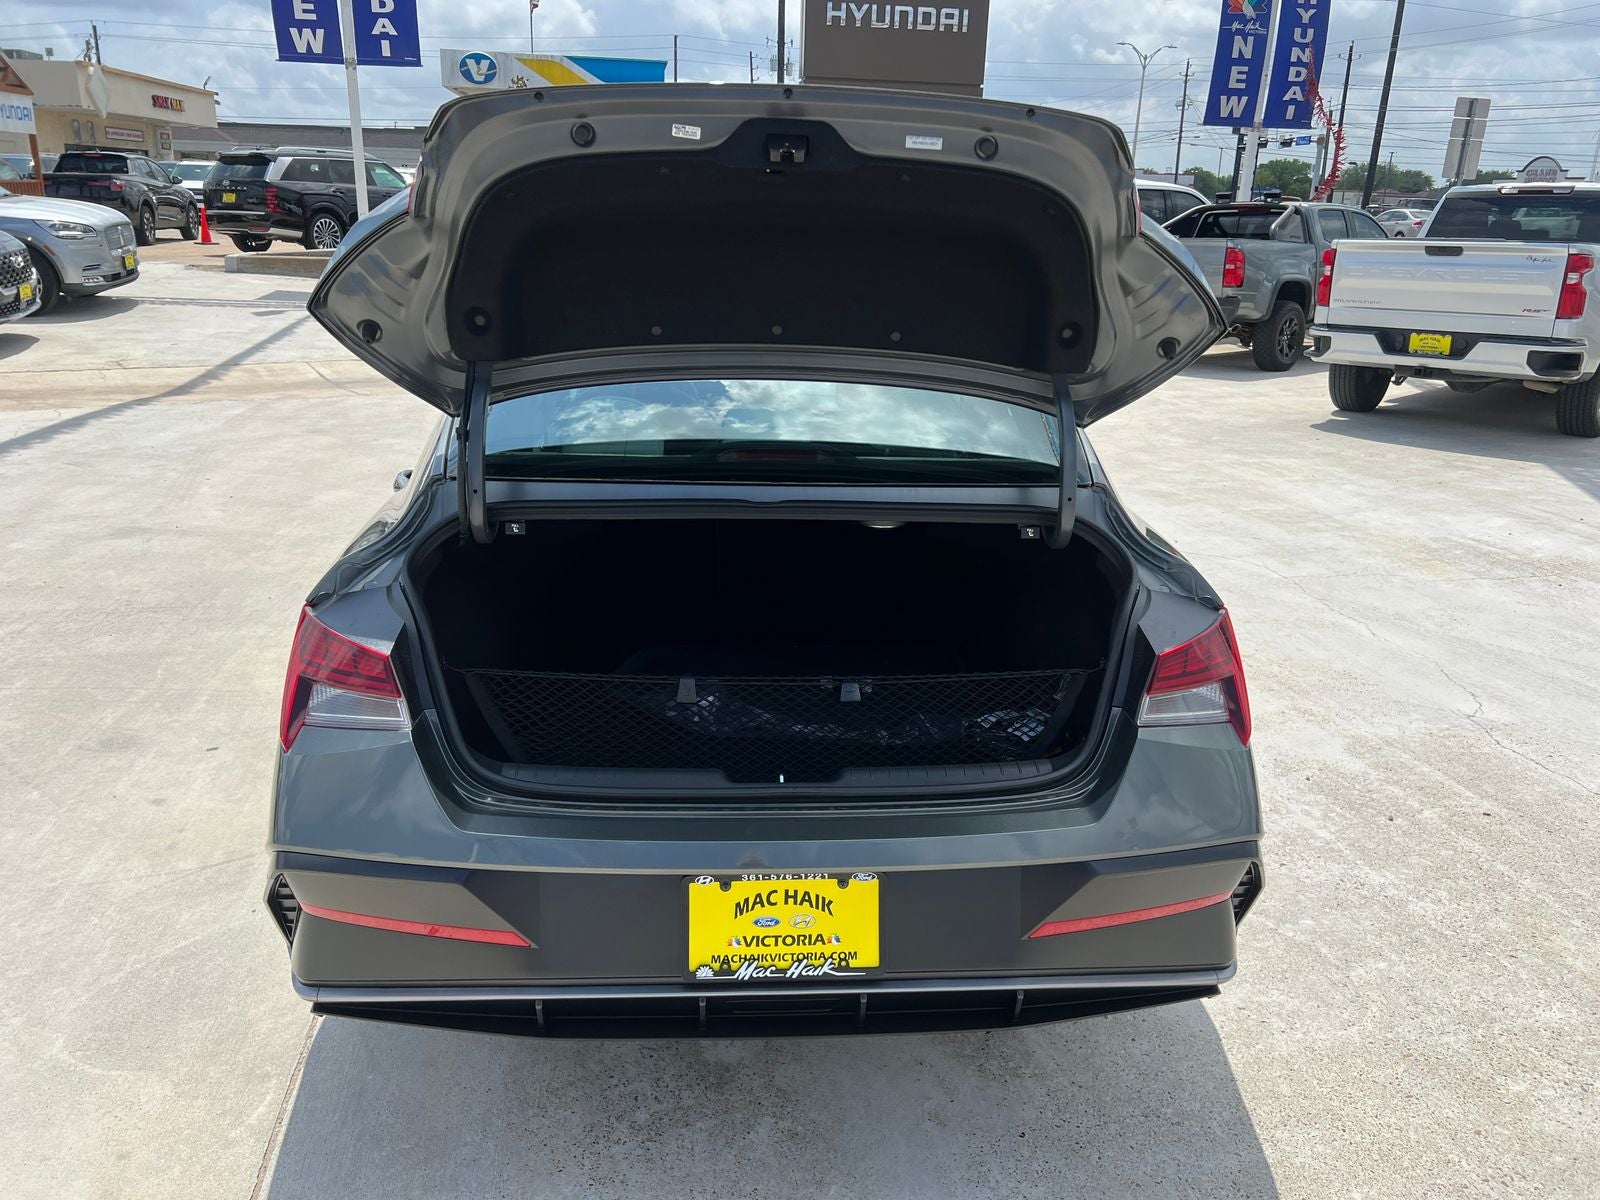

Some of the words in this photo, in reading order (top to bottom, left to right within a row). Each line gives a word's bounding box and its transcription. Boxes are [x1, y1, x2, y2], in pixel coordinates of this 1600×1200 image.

[826, 1, 969, 33] HYUNDAI
[1220, 35, 1254, 118] NEW
[741, 873, 830, 882] 361-576-1221
[734, 889, 778, 920] MAC
[783, 889, 834, 918] HAIK
[756, 917, 777, 927] Ford
[742, 933, 827, 948] VICTORIA
[710, 951, 858, 964] MACHAIKVICTORIA.COM
[733, 960, 784, 980] Mac
[785, 958, 850, 979] Haik
